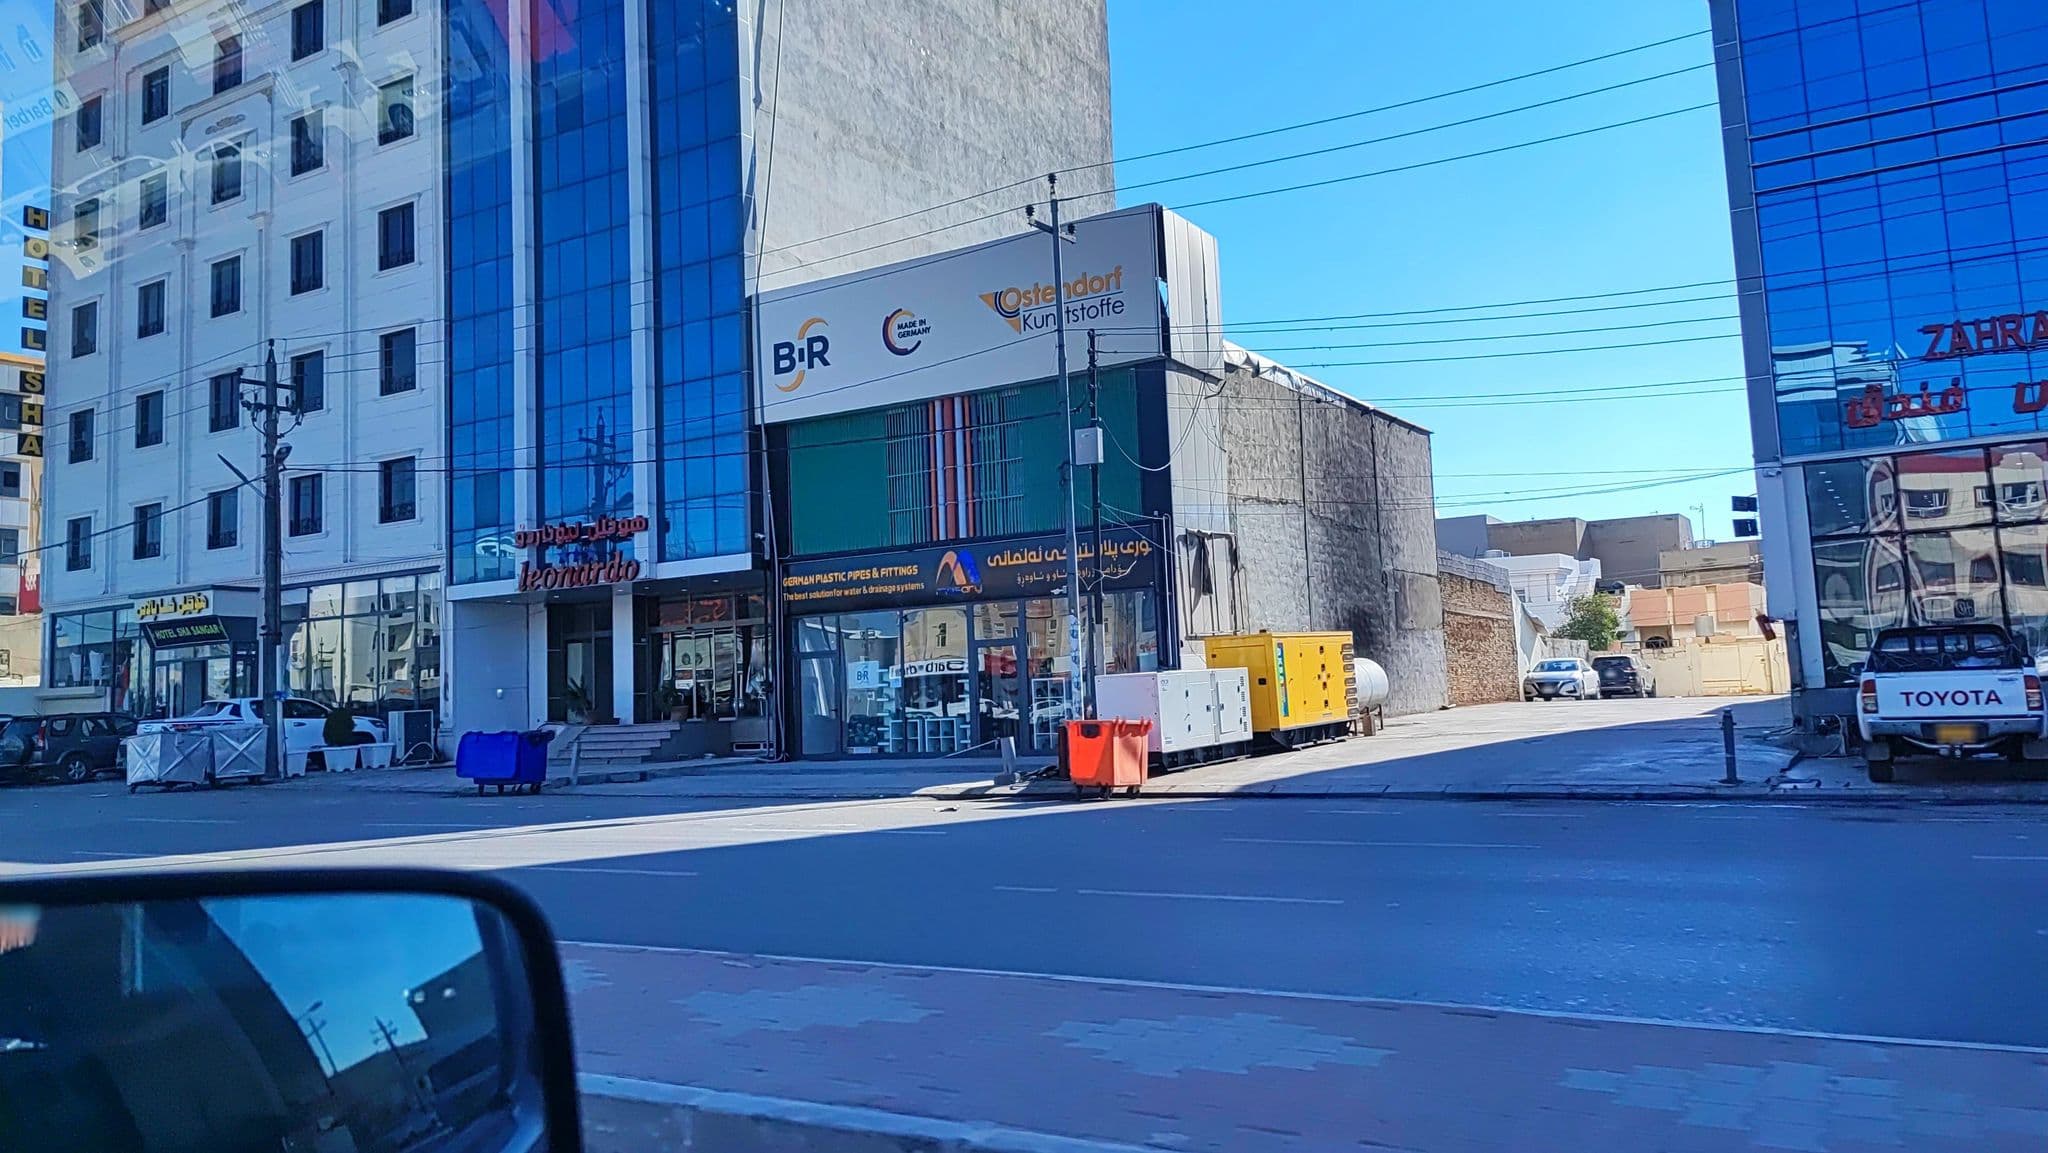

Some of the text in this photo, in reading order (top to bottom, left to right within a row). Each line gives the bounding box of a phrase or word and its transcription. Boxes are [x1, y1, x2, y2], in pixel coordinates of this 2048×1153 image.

[1002, 265, 1122, 310] Ostendorf
[897, 318, 927, 331] MADE IN
[1023, 297, 1125, 331] Kuntstoffe
[21, 206, 48, 454] HOTEL SHA
[897, 325, 931, 339] GERMANY
[1922, 309, 2048, 360] ZAHRA
[518, 551, 640, 592] leonardo
[783, 575, 815, 587] GERMAN
[847, 568, 871, 581] PIPES
[872, 567, 880, 579] &
[881, 565, 919, 577] FITTINGS
[783, 592, 793, 602] The
[793, 590, 808, 601] best
[809, 587, 832, 600] solution
[832, 586, 842, 597] for
[843, 586, 862, 597] water
[869, 583, 896, 596] drainage
[896, 581, 925, 593] systems
[154, 624, 220, 639] HOTEL SHA SANGAR
[1900, 689, 2003, 708] TOYOTA
